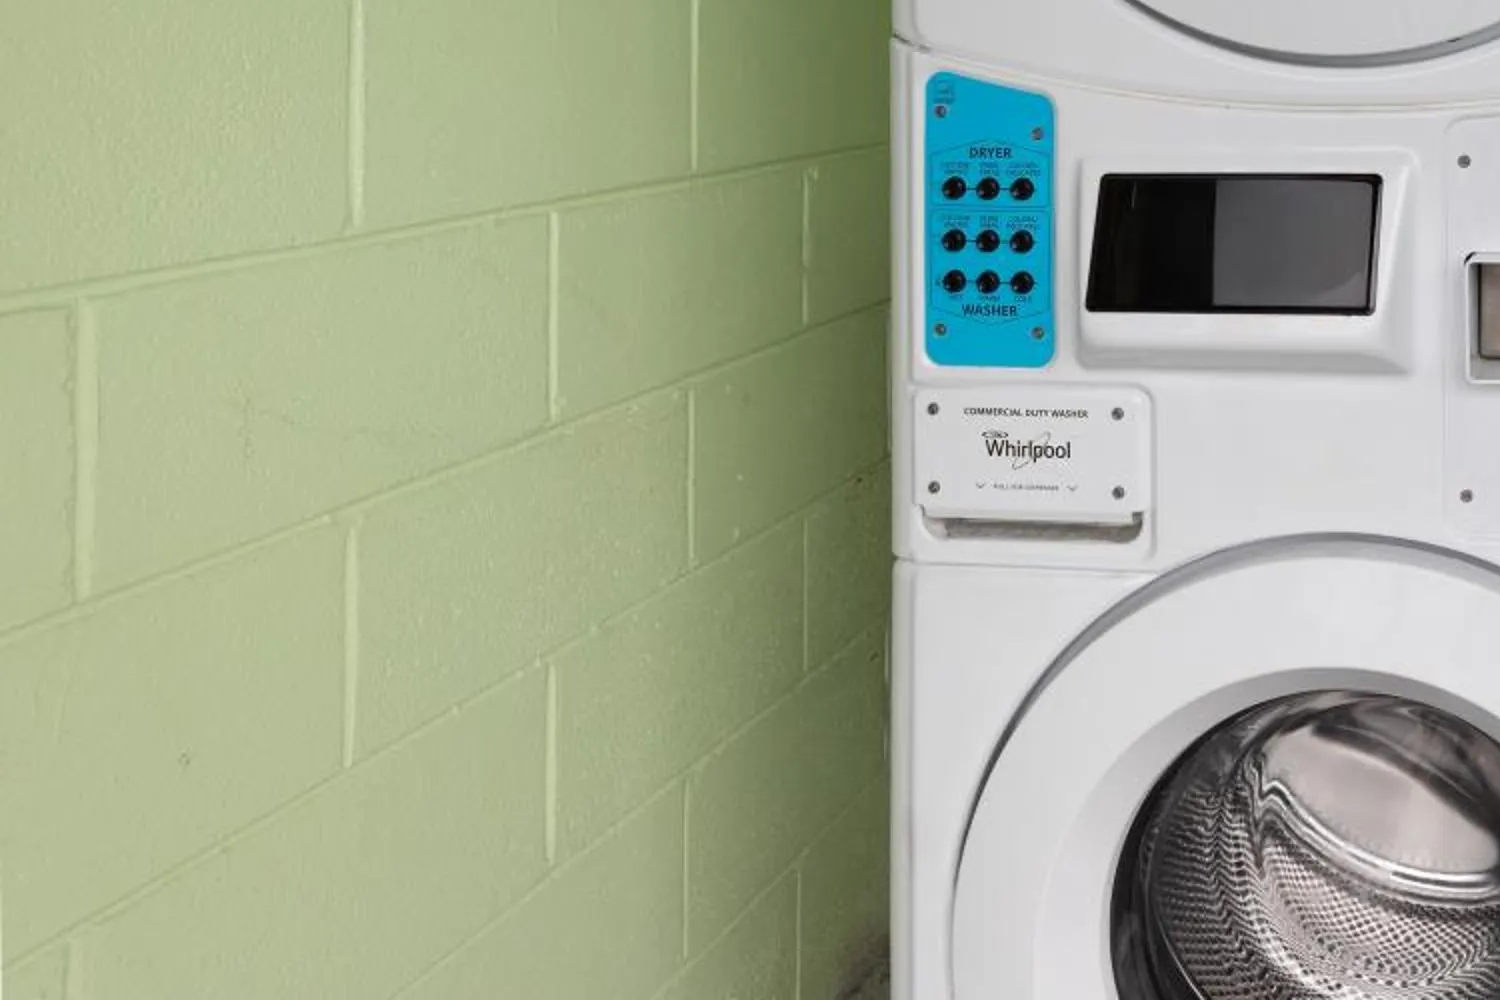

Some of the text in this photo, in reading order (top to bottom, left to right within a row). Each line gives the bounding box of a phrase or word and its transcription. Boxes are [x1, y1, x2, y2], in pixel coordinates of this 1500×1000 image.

[969, 147, 1013, 159] DRYER
[962, 304, 1018, 317] WASHER
[964, 407, 1089, 418] COMMERCIAL DUTY WASHER
[985, 439, 1071, 462] Whirlpool
